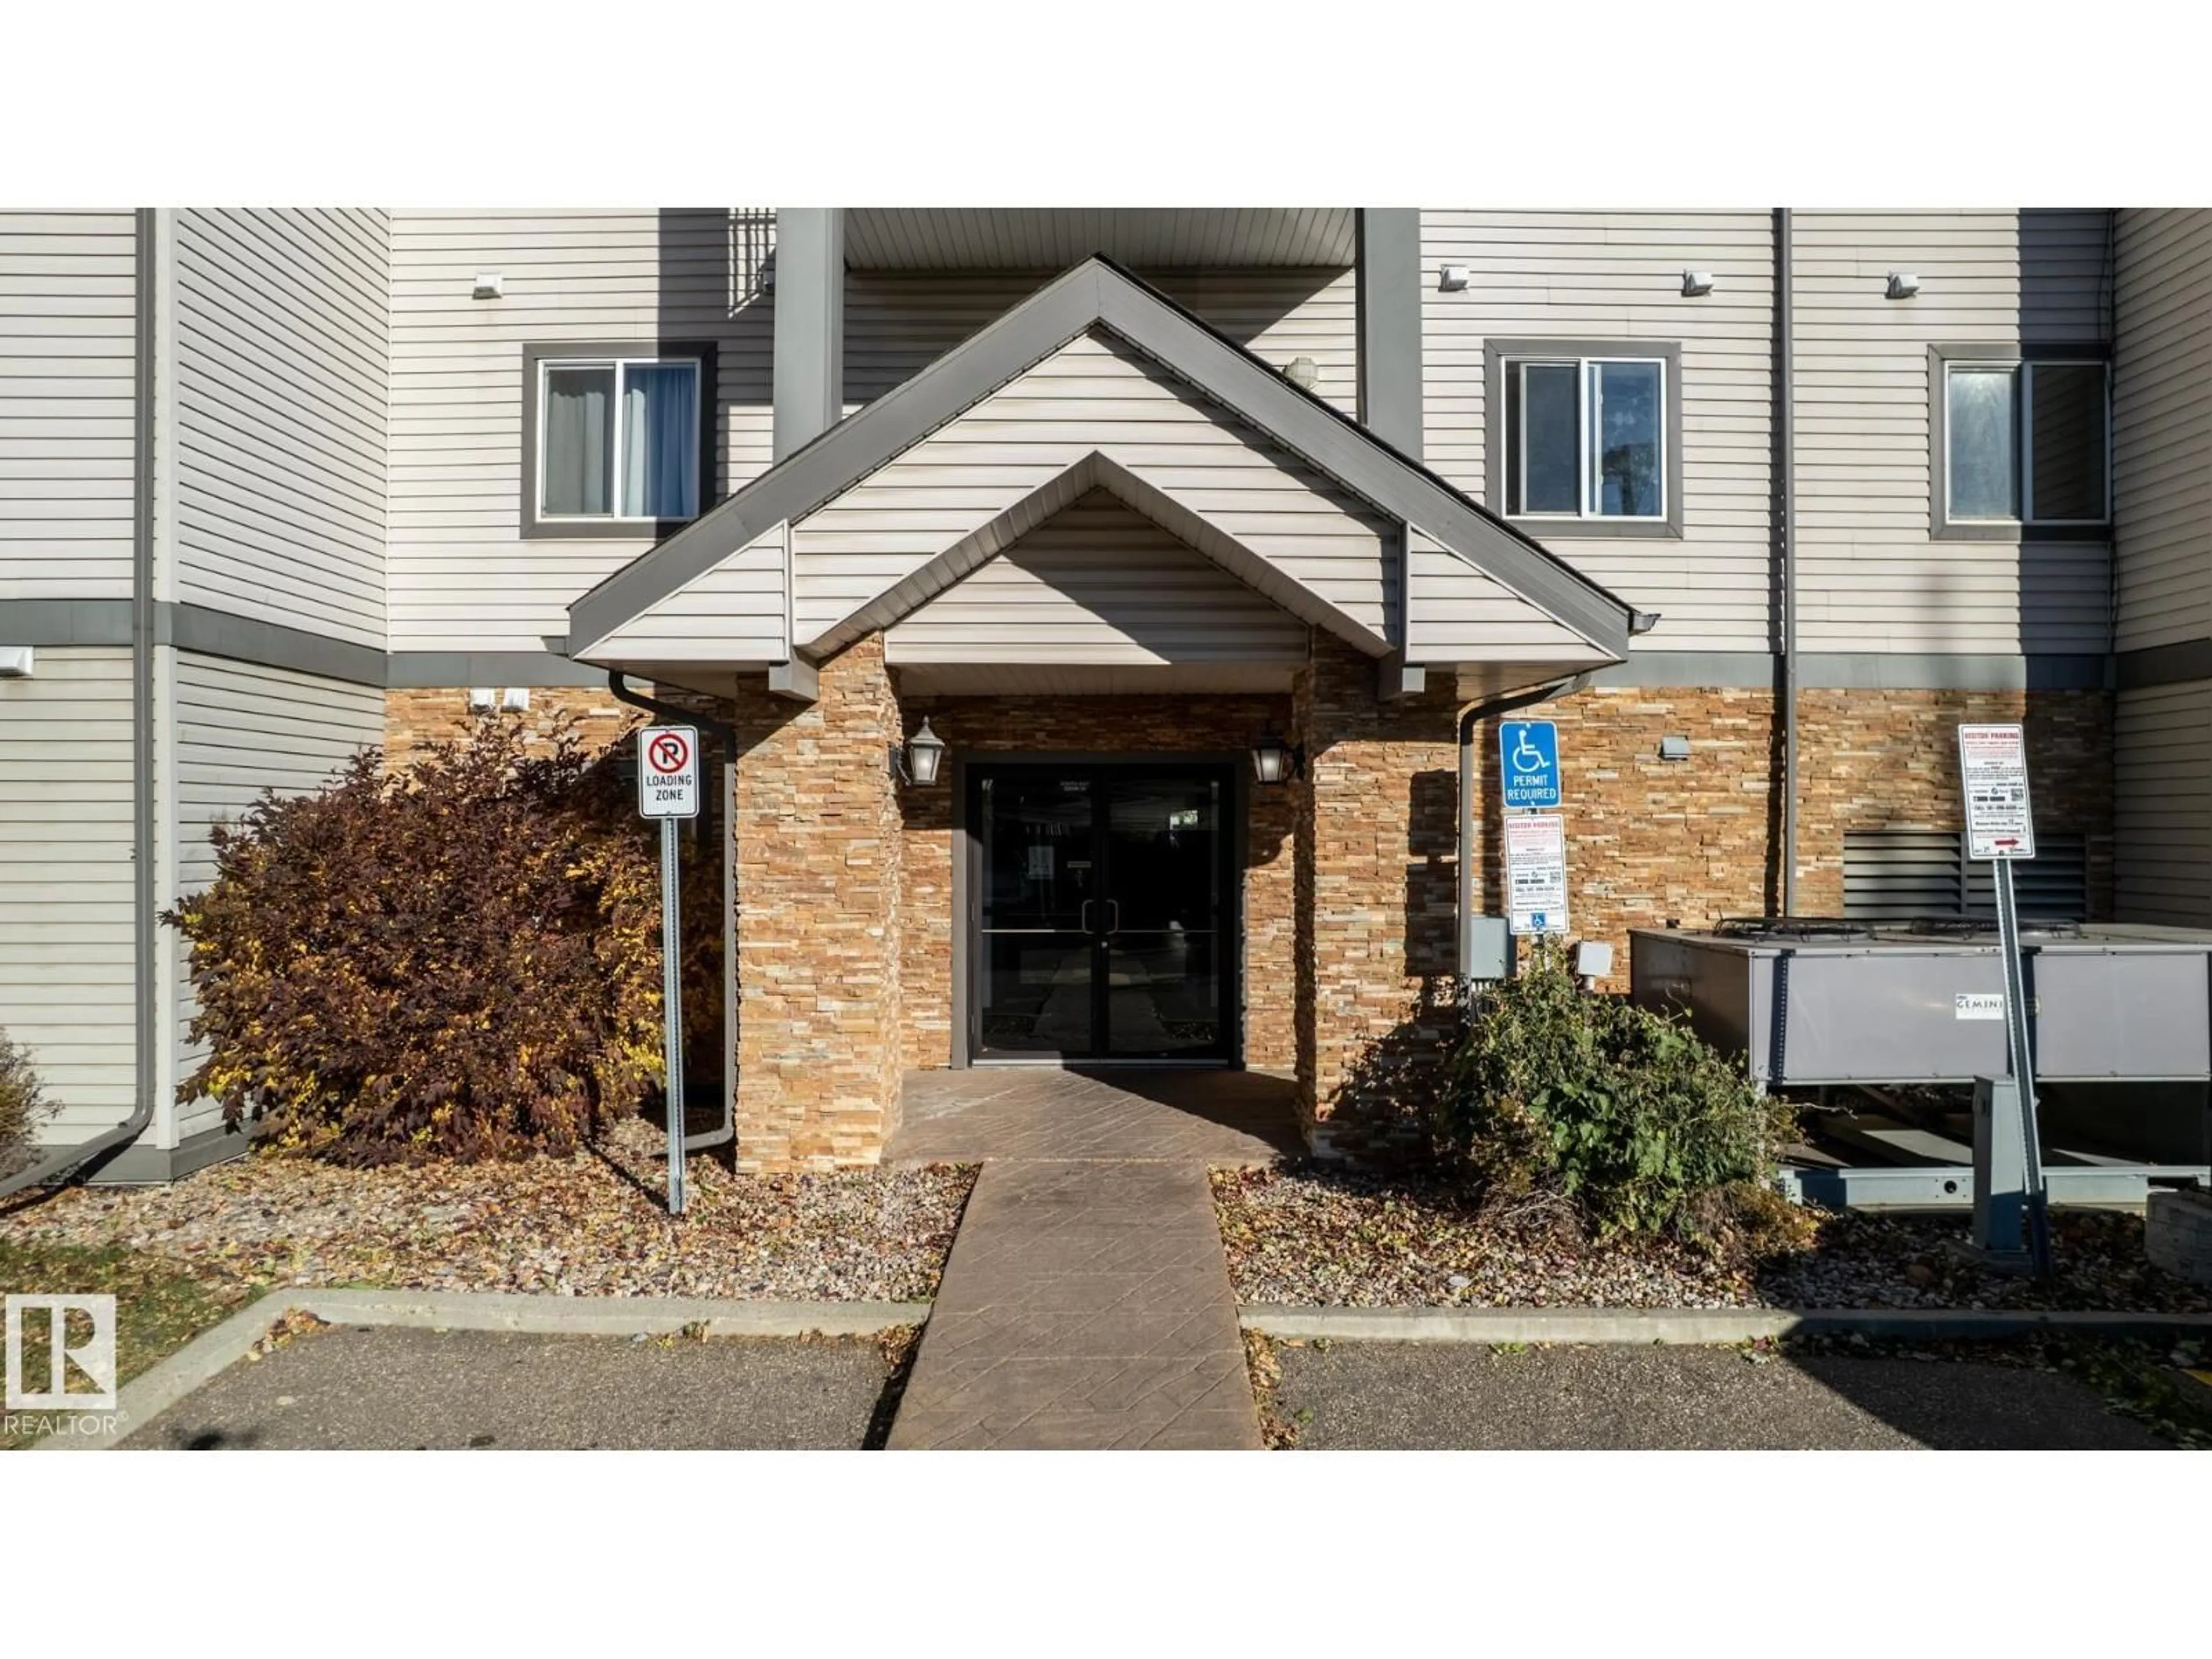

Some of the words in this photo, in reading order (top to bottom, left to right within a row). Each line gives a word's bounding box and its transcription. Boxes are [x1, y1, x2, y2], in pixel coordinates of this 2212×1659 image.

[646, 775, 692, 786] LOADING
[1513, 774, 1548, 787] PERMIT
[656, 789, 684, 801] ZONE
[1507, 788, 1556, 801] REQUIRED
[1957, 1000, 2002, 1009] GEMINI
